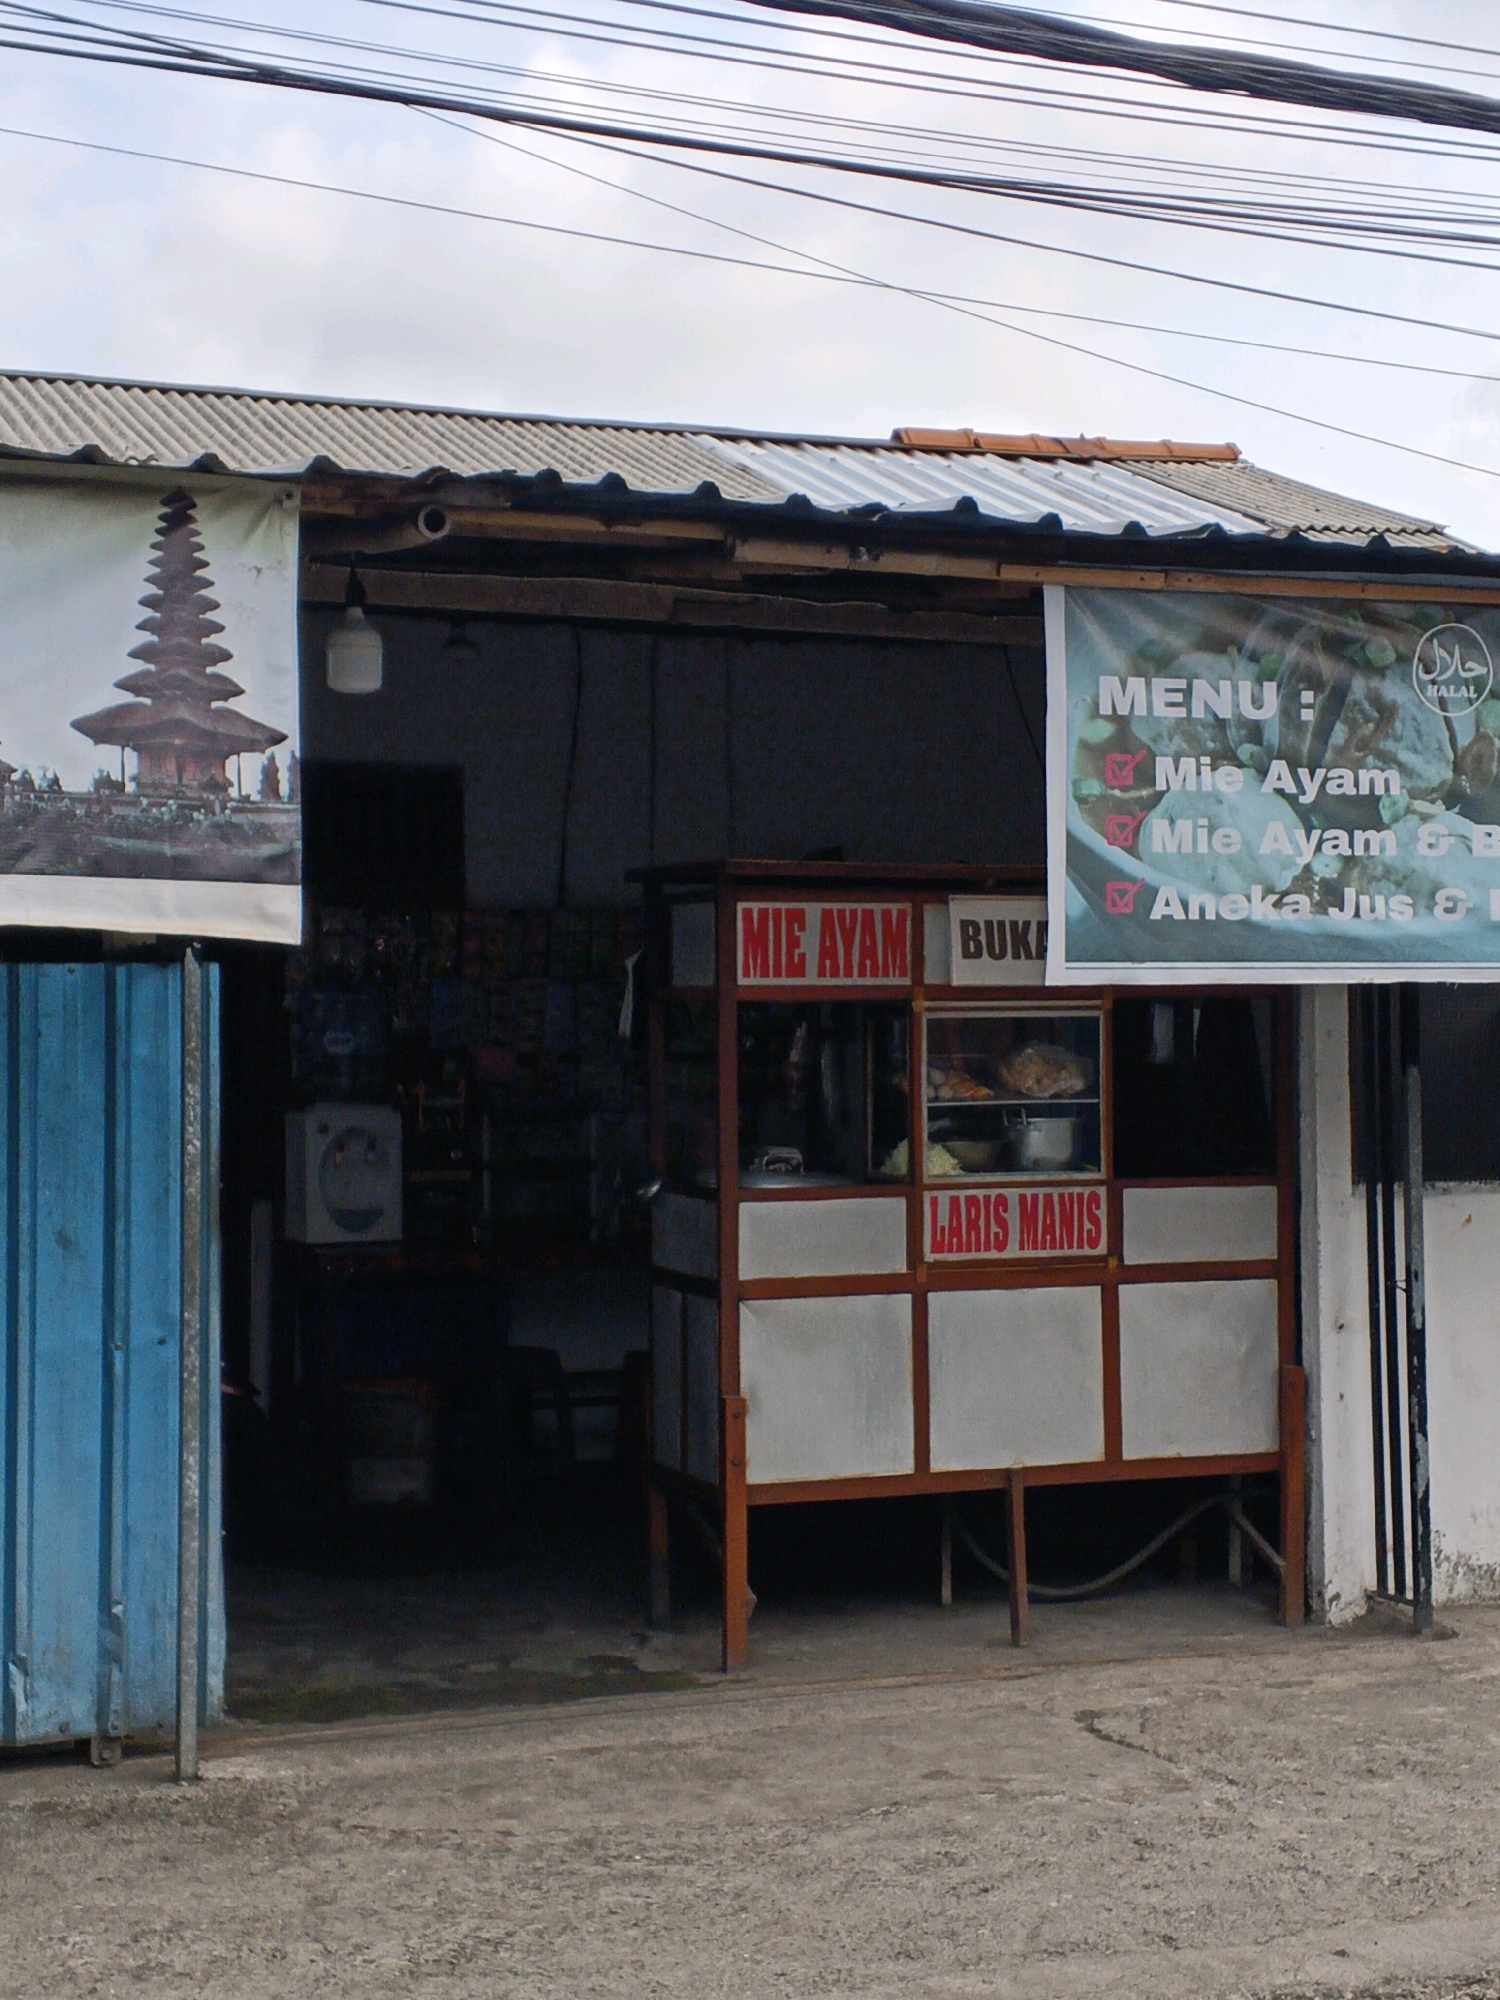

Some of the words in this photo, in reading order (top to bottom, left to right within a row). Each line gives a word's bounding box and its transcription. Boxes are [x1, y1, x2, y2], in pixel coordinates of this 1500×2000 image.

[1098, 675, 1279, 721] MENU
[1426, 684, 1477, 698] HALAL
[1154, 756, 1244, 793] Mie
[1260, 759, 1401, 804] Ayam
[1150, 818, 1242, 855] Mie
[1258, 821, 1397, 865] Ayam
[1416, 823, 1455, 857] &
[1149, 884, 1314, 921] Aneka
[1328, 889, 1414, 921] Jus
[1433, 888, 1473, 921] &
[741, 906, 806, 979] MIE
[817, 906, 909, 979] AYAM
[929, 1191, 1009, 1255] LARIS
[1018, 1190, 1102, 1252] MANIS
